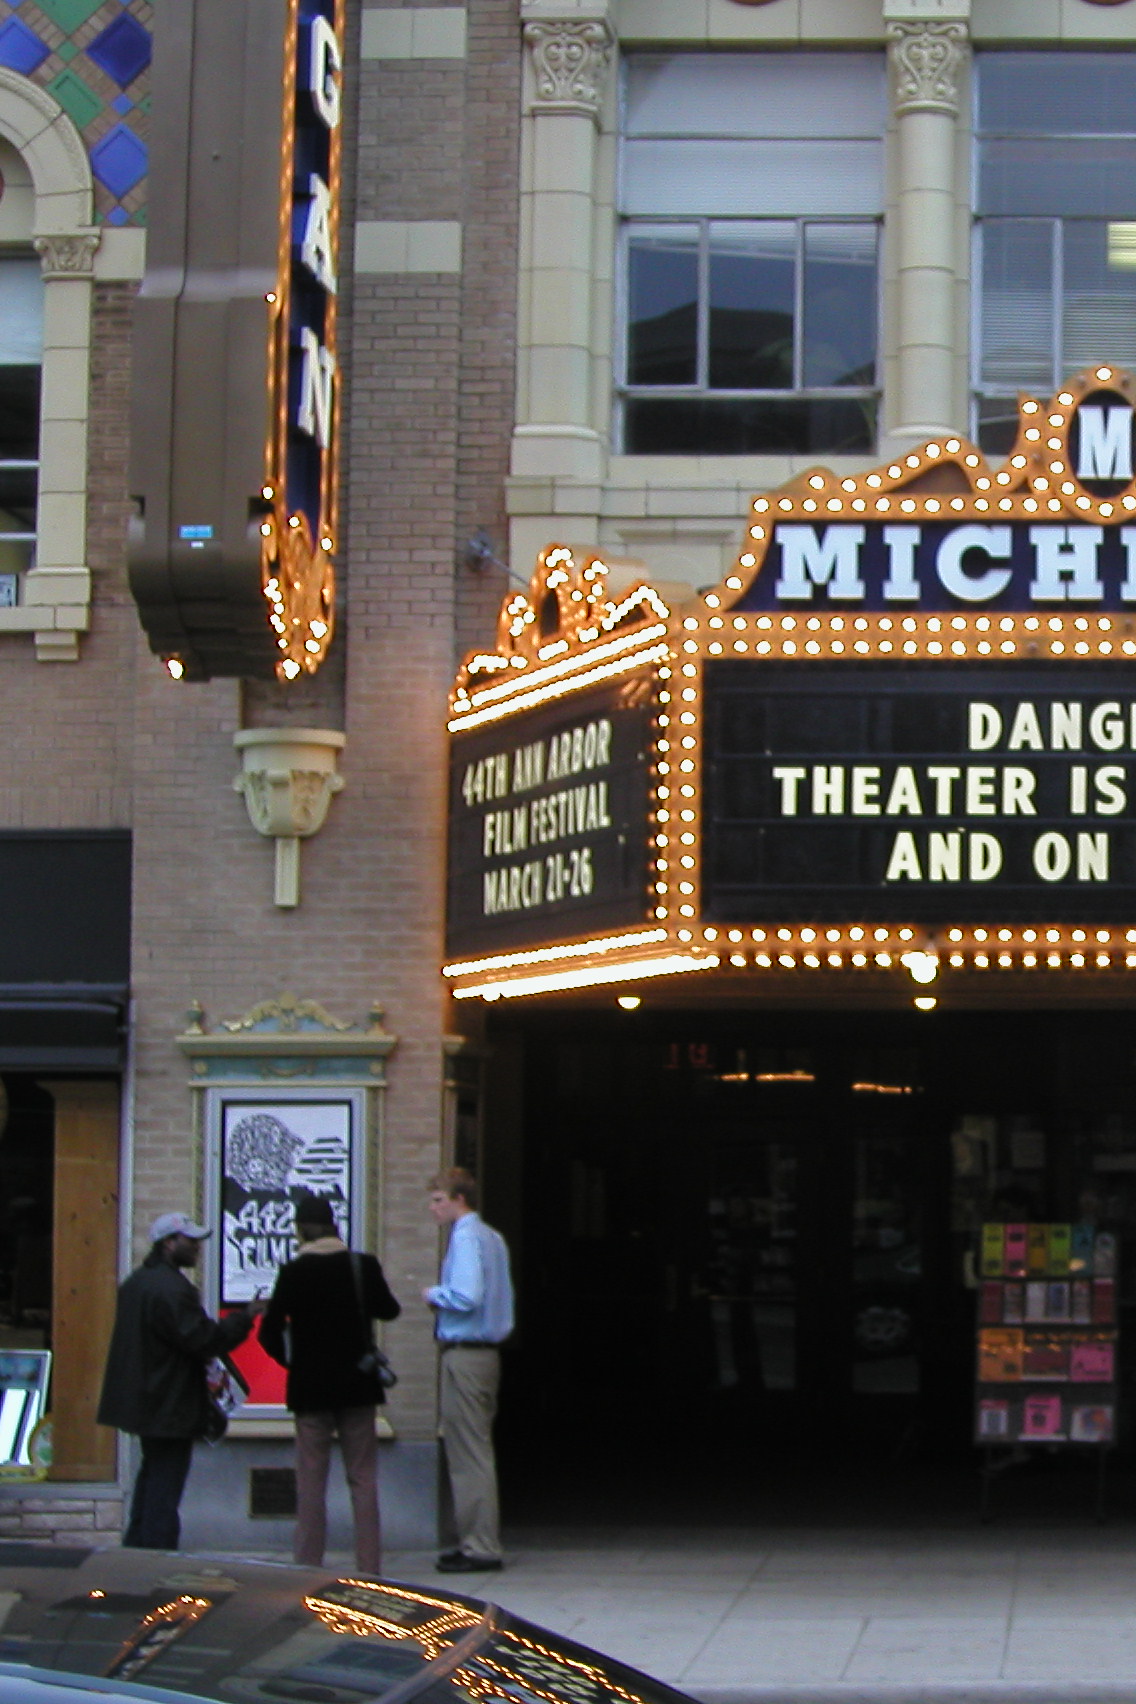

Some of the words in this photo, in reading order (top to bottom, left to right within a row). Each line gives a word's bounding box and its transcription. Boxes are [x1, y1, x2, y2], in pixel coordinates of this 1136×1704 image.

[1077, 407, 1133, 480] M
[462, 753, 508, 807] 44TH
[512, 741, 545, 793] ANN
[547, 718, 612, 781] ARBOR
[772, 766, 1037, 816] THEATER
[1070, 766, 1127, 816] IS
[483, 803, 528, 857] FILM
[530, 781, 612, 845] FESTIVAL
[483, 860, 543, 916] MARCH
[546, 847, 593, 901] 21-26
[886, 831, 1003, 882] AND
[1033, 831, 1109, 882] ON
